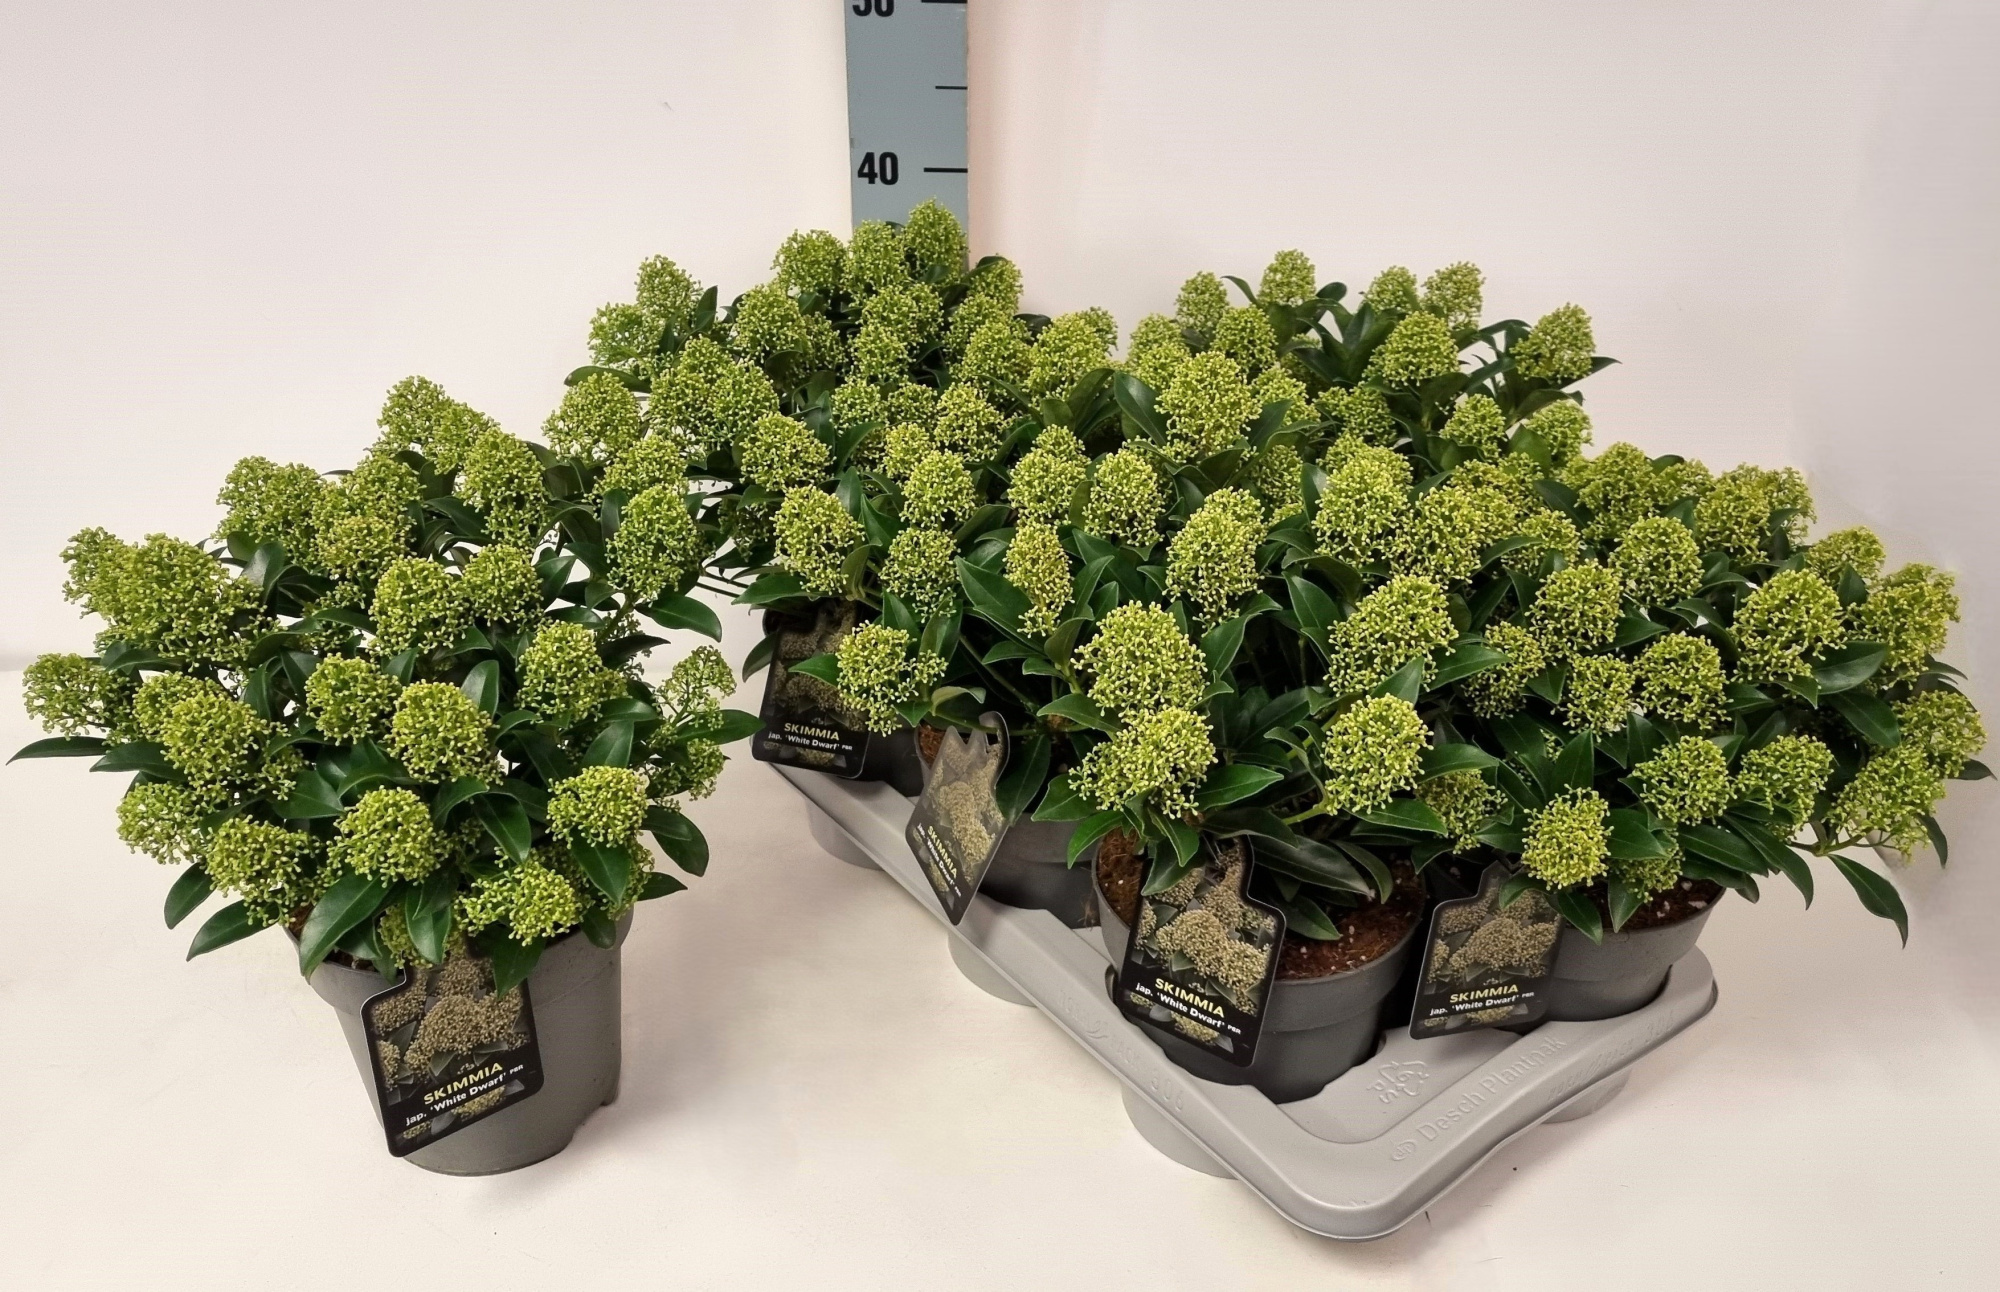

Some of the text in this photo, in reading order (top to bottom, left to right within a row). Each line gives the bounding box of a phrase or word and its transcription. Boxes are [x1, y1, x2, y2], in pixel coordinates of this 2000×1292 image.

[857, 152, 899, 185] 40
[768, 731, 782, 740] jap.
[785, 735, 810, 746] 'White
[811, 739, 840, 750] Dwarf'
[784, 722, 840, 741] SKIMMIA
[927, 825, 957, 879] SKIMMIA
[1135, 982, 1153, 997] jap.
[1157, 992, 1188, 1013] 'White
[1189, 1007, 1226, 1028] Dwarf'
[1155, 978, 1225, 1018] SKIMMIA
[1430, 1008, 1448, 1016] jap.
[1451, 1001, 1483, 1012] 'White
[1485, 994, 1520, 1006] Dwarf'
[1450, 984, 1519, 1003] SKIMMIA
[405, 1112, 427, 1126] jap.
[430, 1092, 467, 1113] 'White
[469, 1072, 506, 1096] Dwarf'
[423, 1062, 503, 1105] SKIMMIA
[1416, 1090, 1487, 1141] Desch
[1480, 1036, 1567, 1095] Plantpak
